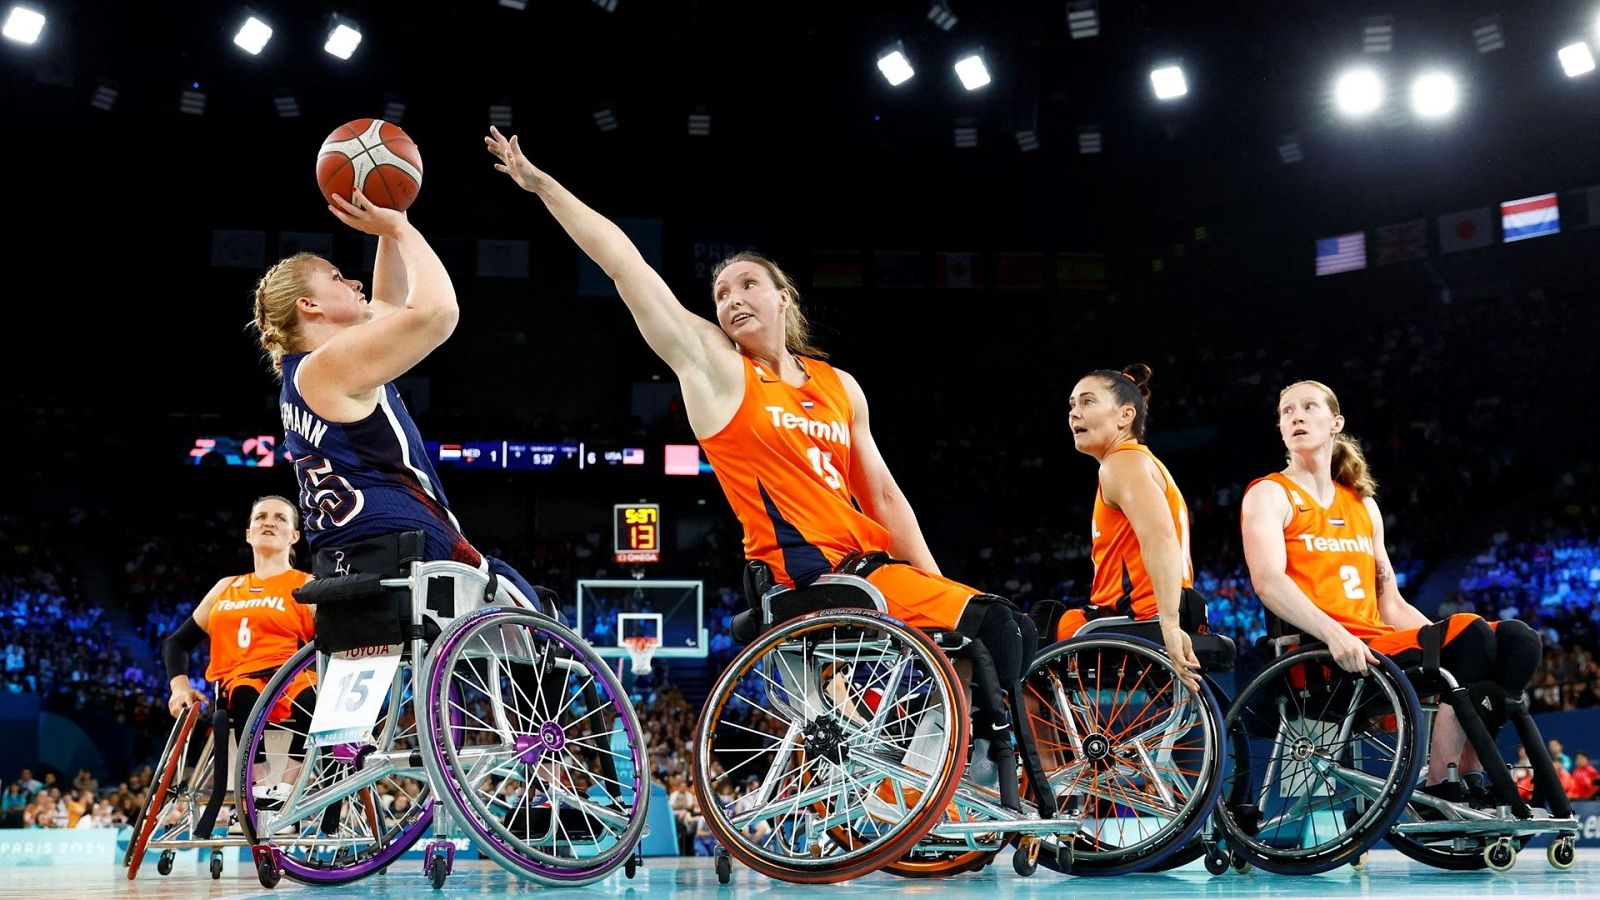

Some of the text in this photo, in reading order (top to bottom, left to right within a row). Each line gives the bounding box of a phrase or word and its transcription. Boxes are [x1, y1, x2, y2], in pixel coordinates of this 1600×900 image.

[490, 450, 497, 462] 1
[587, 452, 597, 465] 6
[806, 447, 841, 490] 15
[631, 525, 655, 549] 13
[1339, 564, 1366, 600] 2
[217, 596, 286, 612] TeamNL
[237, 616, 251, 649] 6
[345, 644, 389, 658] TOYOTA
[334, 670, 376, 713] 15
[1, 842, 52, 855] PARIS
